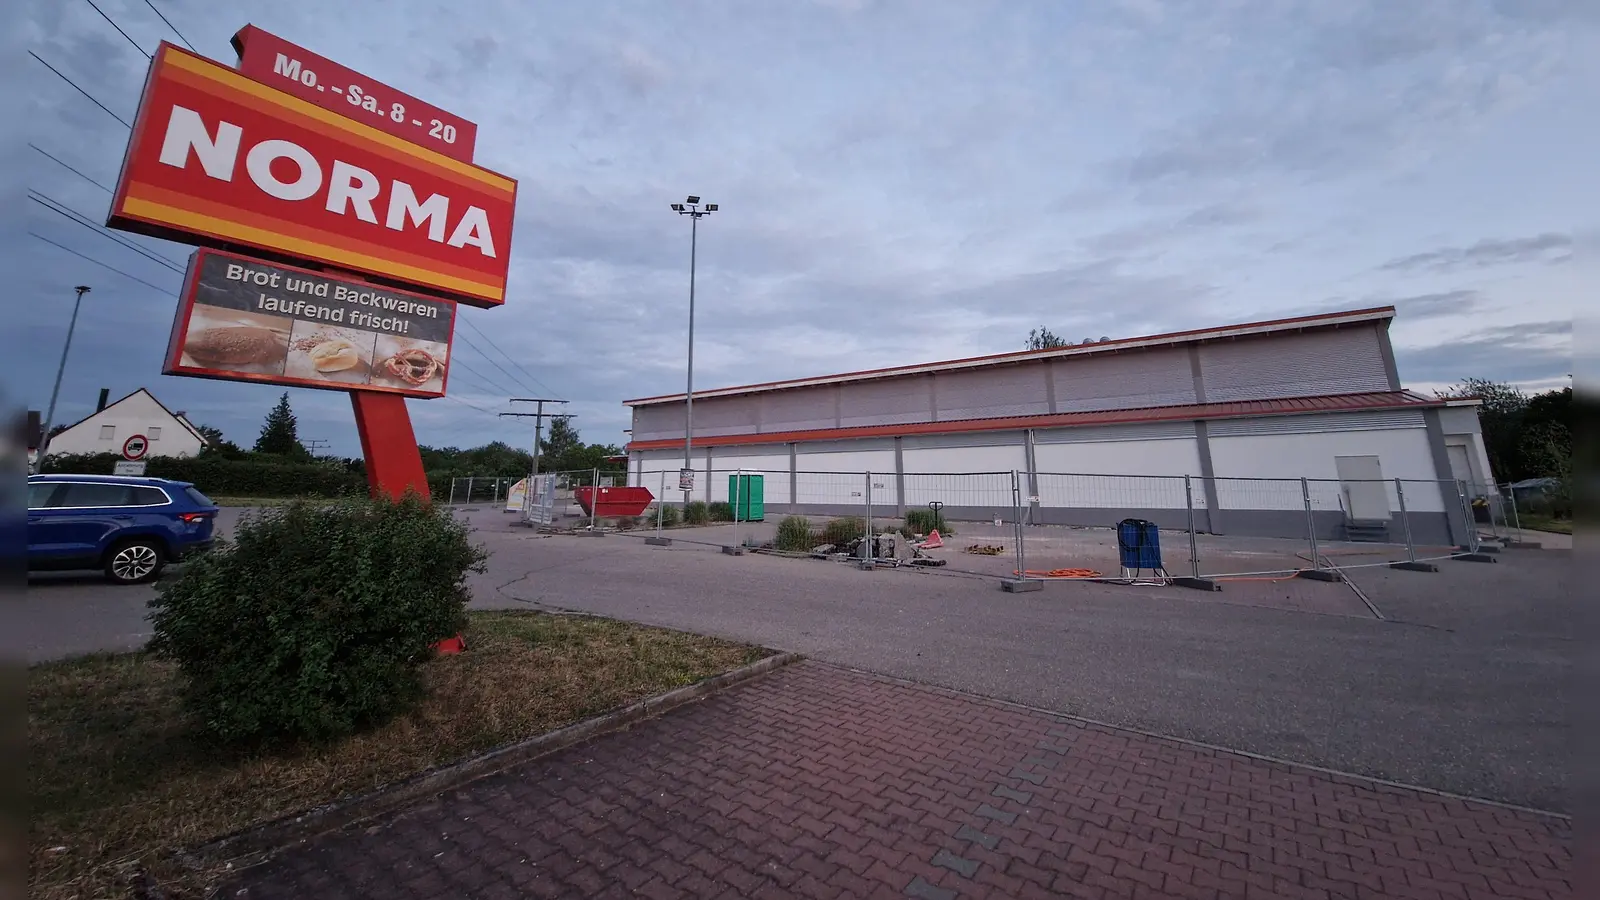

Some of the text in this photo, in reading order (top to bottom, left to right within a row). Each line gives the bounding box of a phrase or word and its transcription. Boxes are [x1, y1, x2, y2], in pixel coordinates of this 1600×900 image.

[274, 52, 325, 92] Mo.
[391, 103, 405, 123] 8
[428, 119, 457, 144] 20
[159, 105, 497, 259] NORMA
[226, 263, 438, 320] Brot und Backwaren
[258, 293, 410, 333] laufend frisch!
